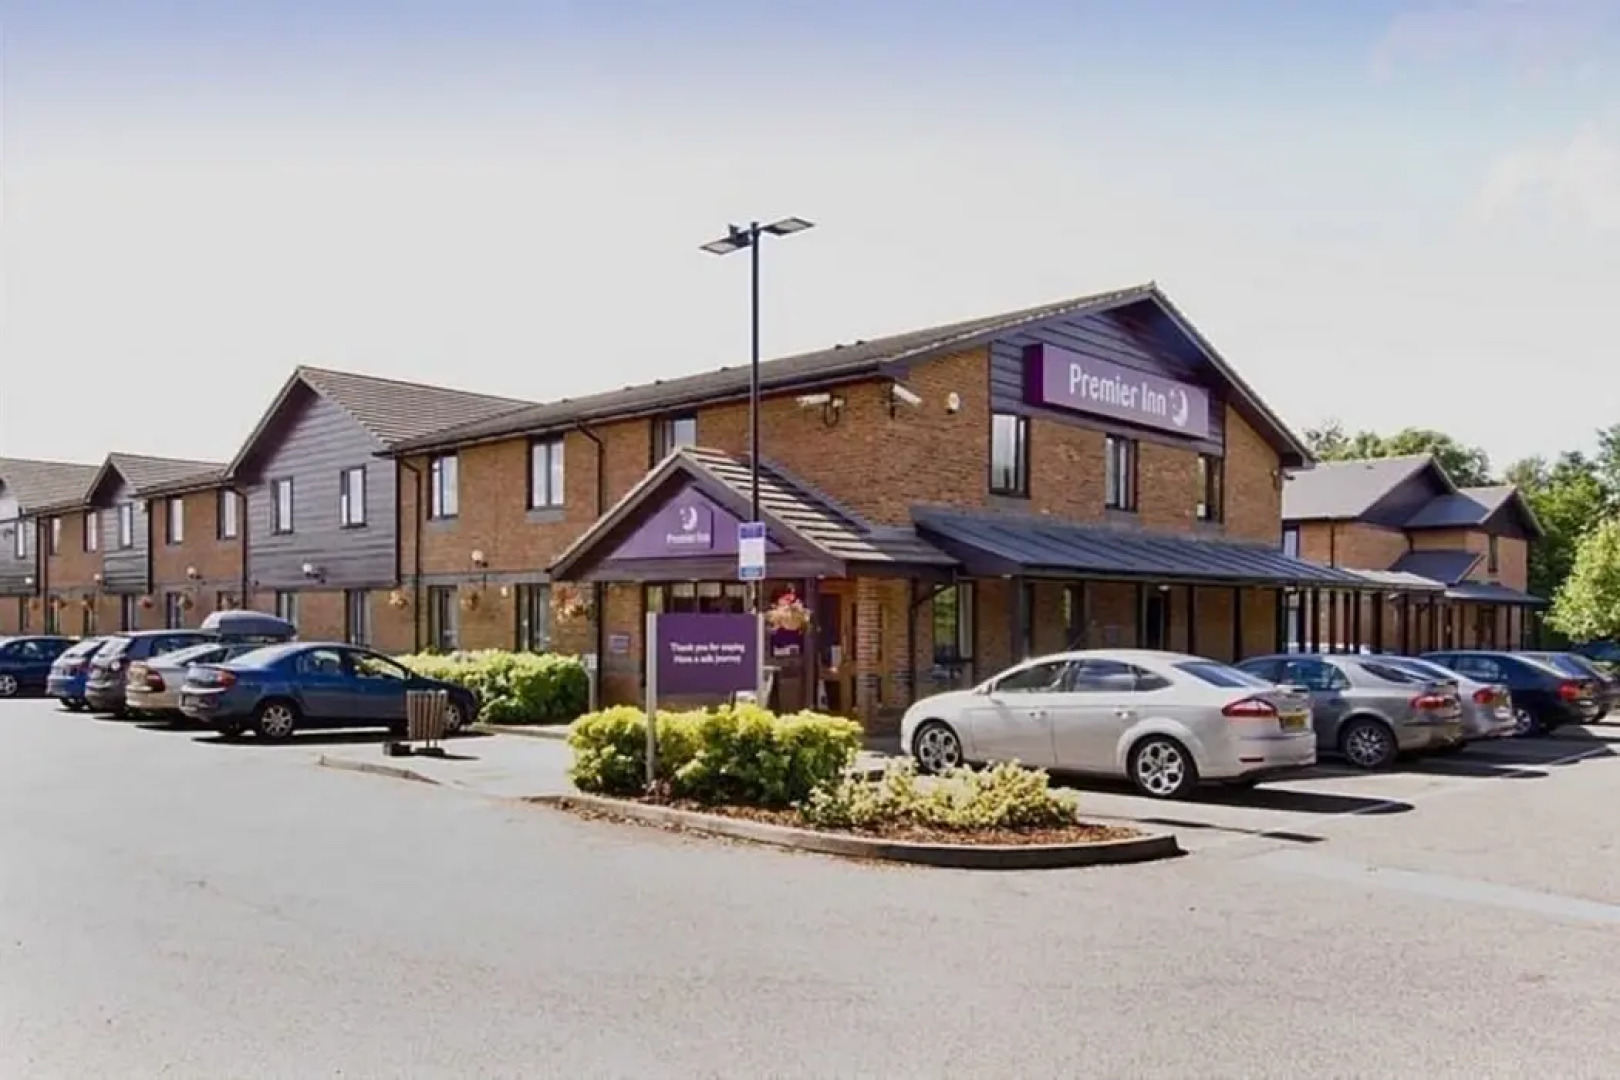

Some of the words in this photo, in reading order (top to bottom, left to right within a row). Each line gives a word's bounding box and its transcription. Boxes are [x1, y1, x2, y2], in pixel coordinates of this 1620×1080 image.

[1069, 363, 1138, 408] Premier
[1142, 381, 1167, 416] Inn
[670, 641, 693, 652] Thank
[695, 644, 708, 654] you
